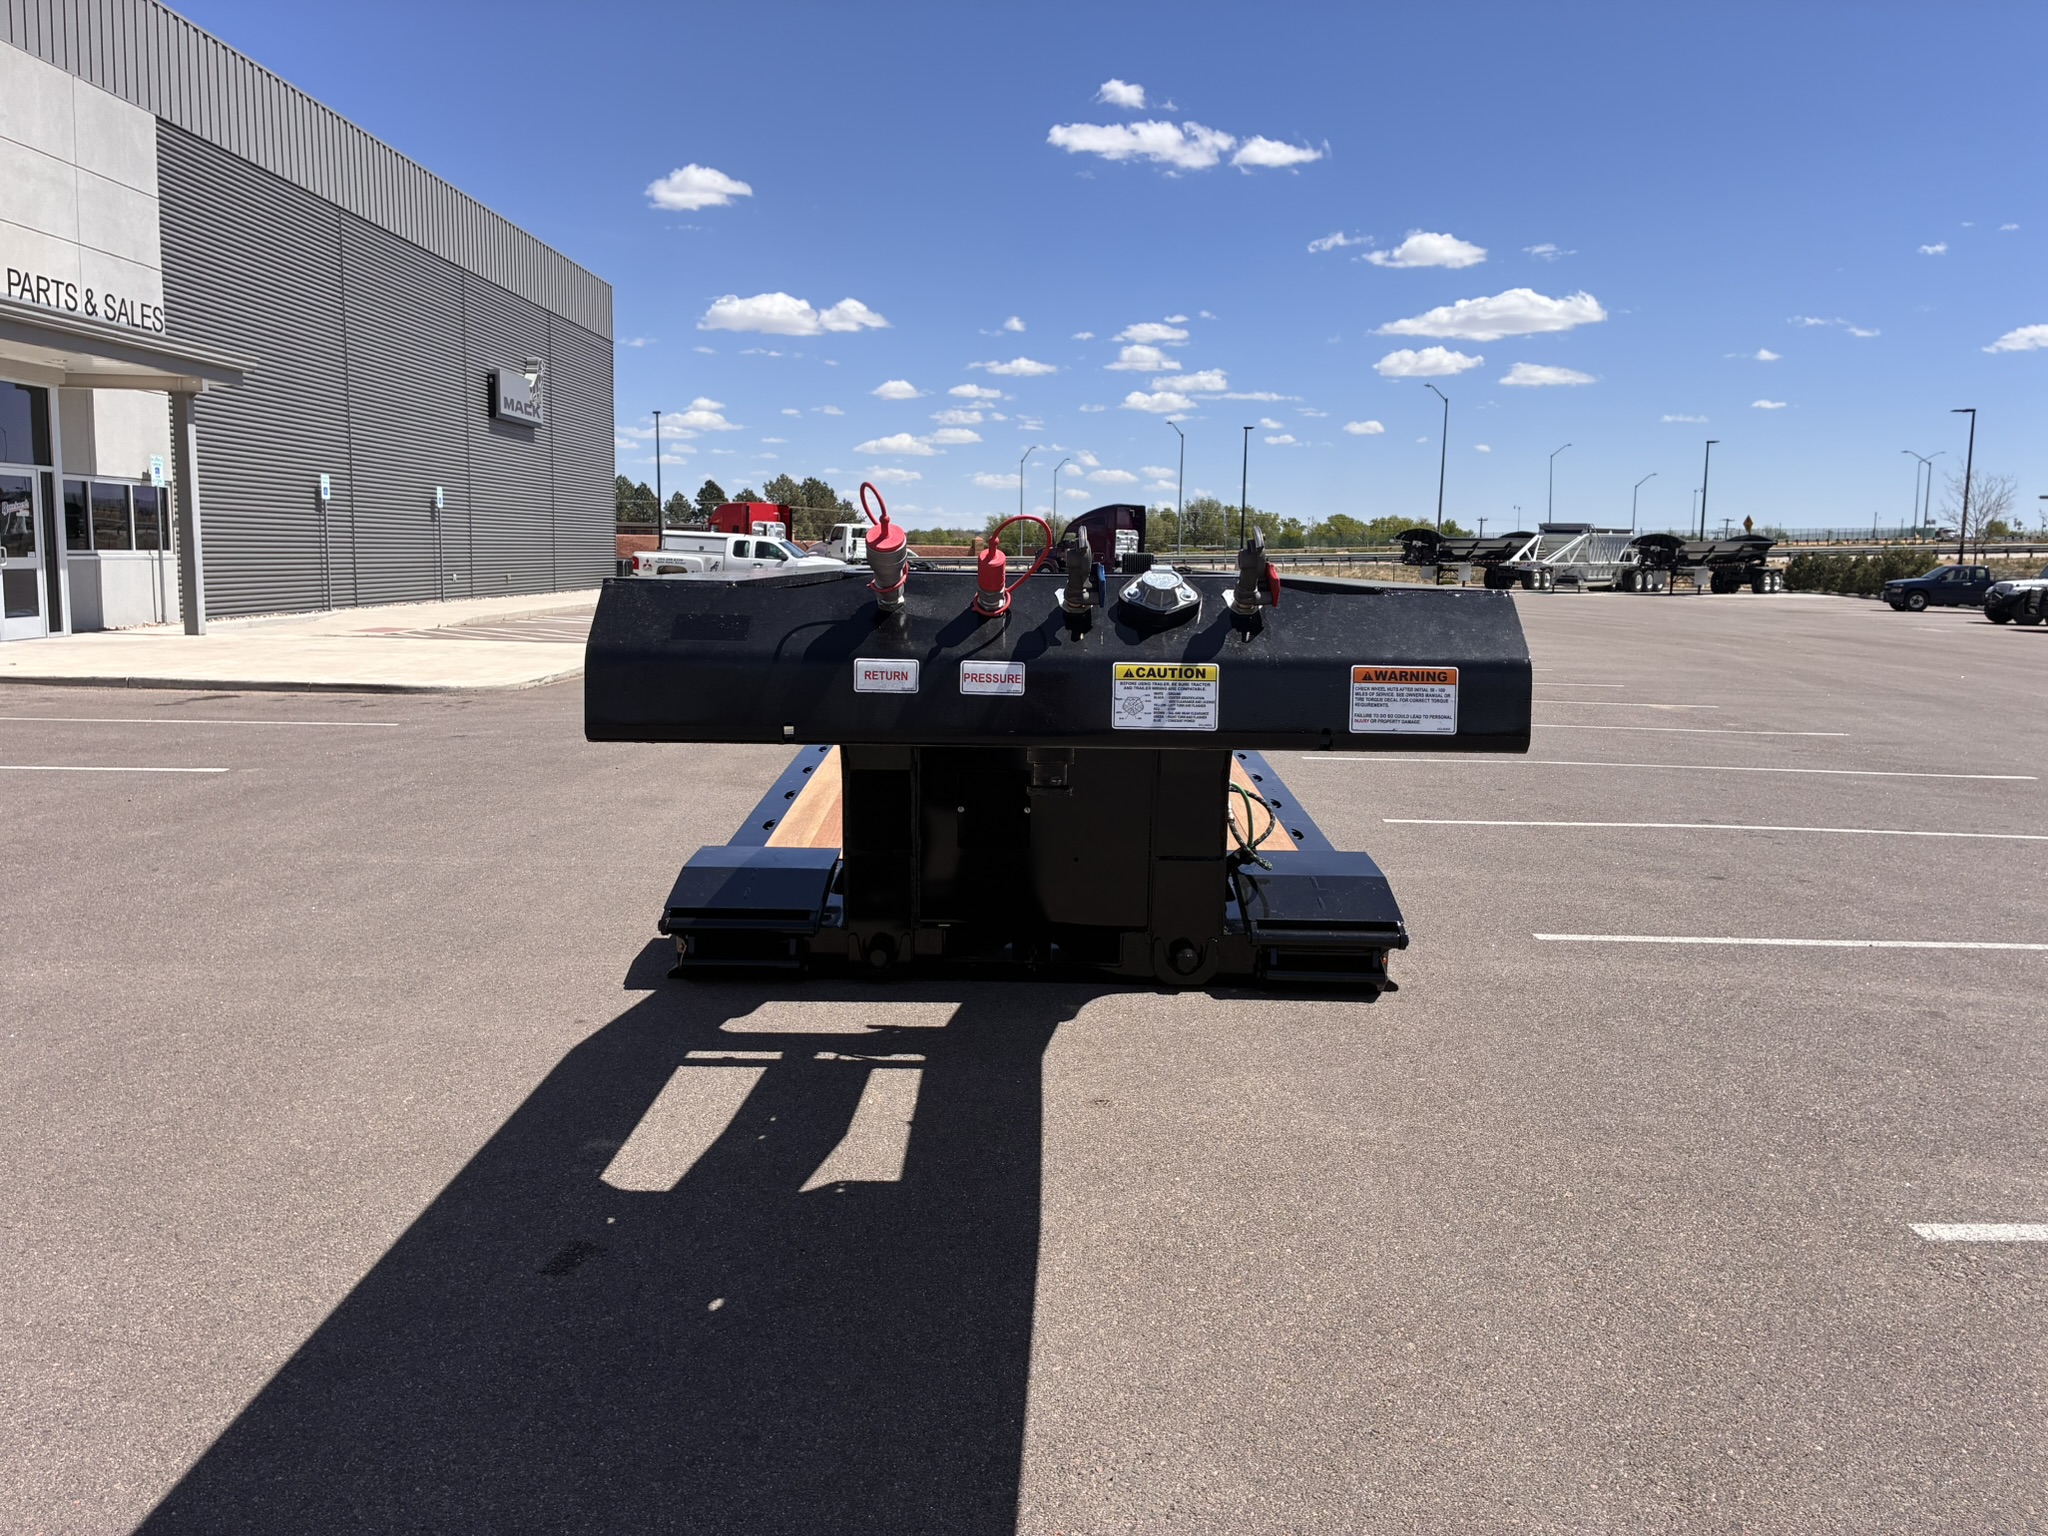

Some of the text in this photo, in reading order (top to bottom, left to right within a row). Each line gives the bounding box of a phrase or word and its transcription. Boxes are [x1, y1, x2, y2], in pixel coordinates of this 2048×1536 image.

[7, 268, 164, 333] PARTS & SALES
[503, 396, 541, 419] MACK
[864, 670, 909, 681] RETURN
[963, 674, 1022, 684] PRESSURE
[1136, 667, 1206, 679] CAUTION
[1374, 670, 1448, 682] WARNING
